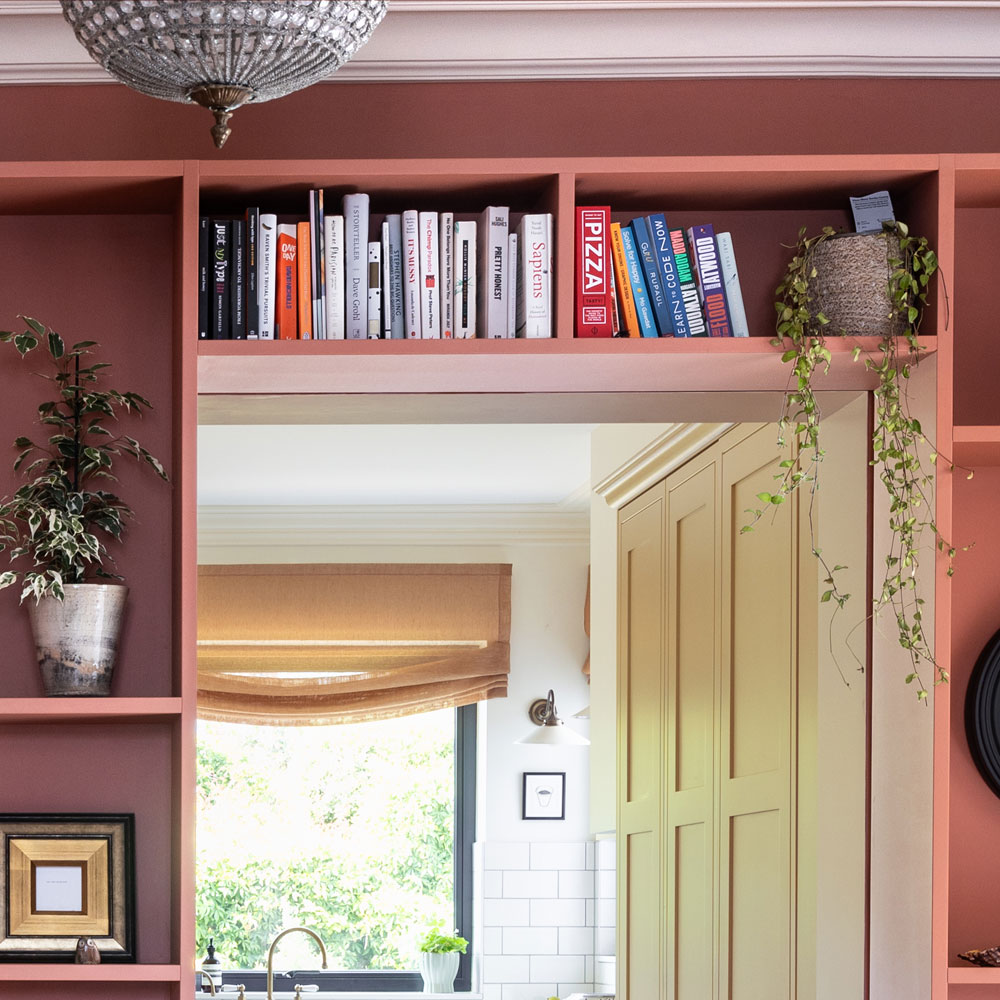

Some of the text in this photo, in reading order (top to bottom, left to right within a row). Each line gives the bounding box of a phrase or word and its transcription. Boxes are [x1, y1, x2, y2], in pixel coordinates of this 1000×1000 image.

[282, 252, 296, 261] DAY
[585, 222, 603, 290] PIZZA
[622, 231, 631, 249] Solve
[630, 261, 640, 284] Happy
[654, 220, 668, 252] NOW
[669, 230, 693, 283] MADDADDAM
[494, 246, 502, 301] PRETTY HONEST
[529, 242, 546, 298] Sapiens
[662, 255, 676, 288] CODE
[696, 236, 720, 284] ATWOOD
[352, 277, 360, 321] Dave Grohl
[394, 282, 402, 316] HAWKING
[650, 272, 663, 307] RUPAUL
[706, 293, 729, 329] FLOOD
[639, 297, 651, 329] Mo Gawdat
[682, 289, 706, 335] ATWOOD
